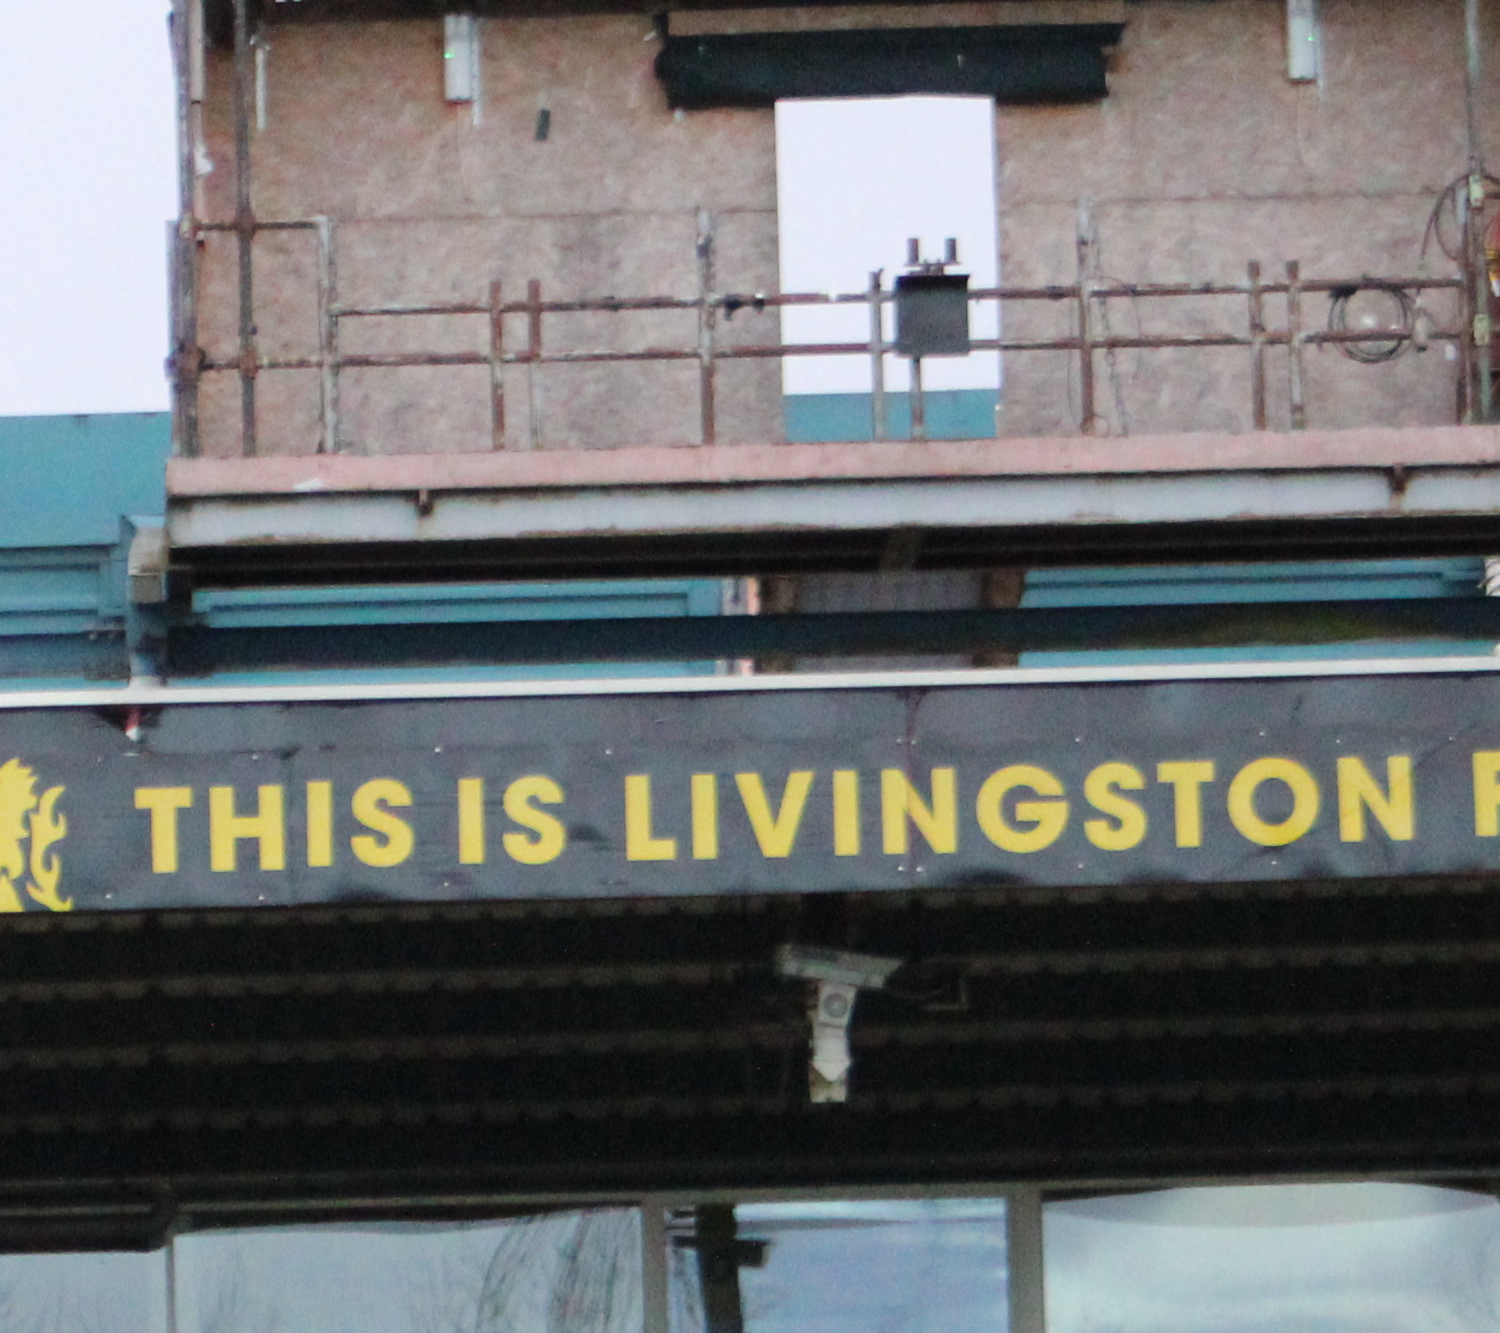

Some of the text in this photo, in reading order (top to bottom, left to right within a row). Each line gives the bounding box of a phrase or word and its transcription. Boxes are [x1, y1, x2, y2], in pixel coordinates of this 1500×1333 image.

[134, 779, 415, 873] THIS
[457, 775, 567, 865] IS
[624, 755, 1416, 862] LIVINGSTON
